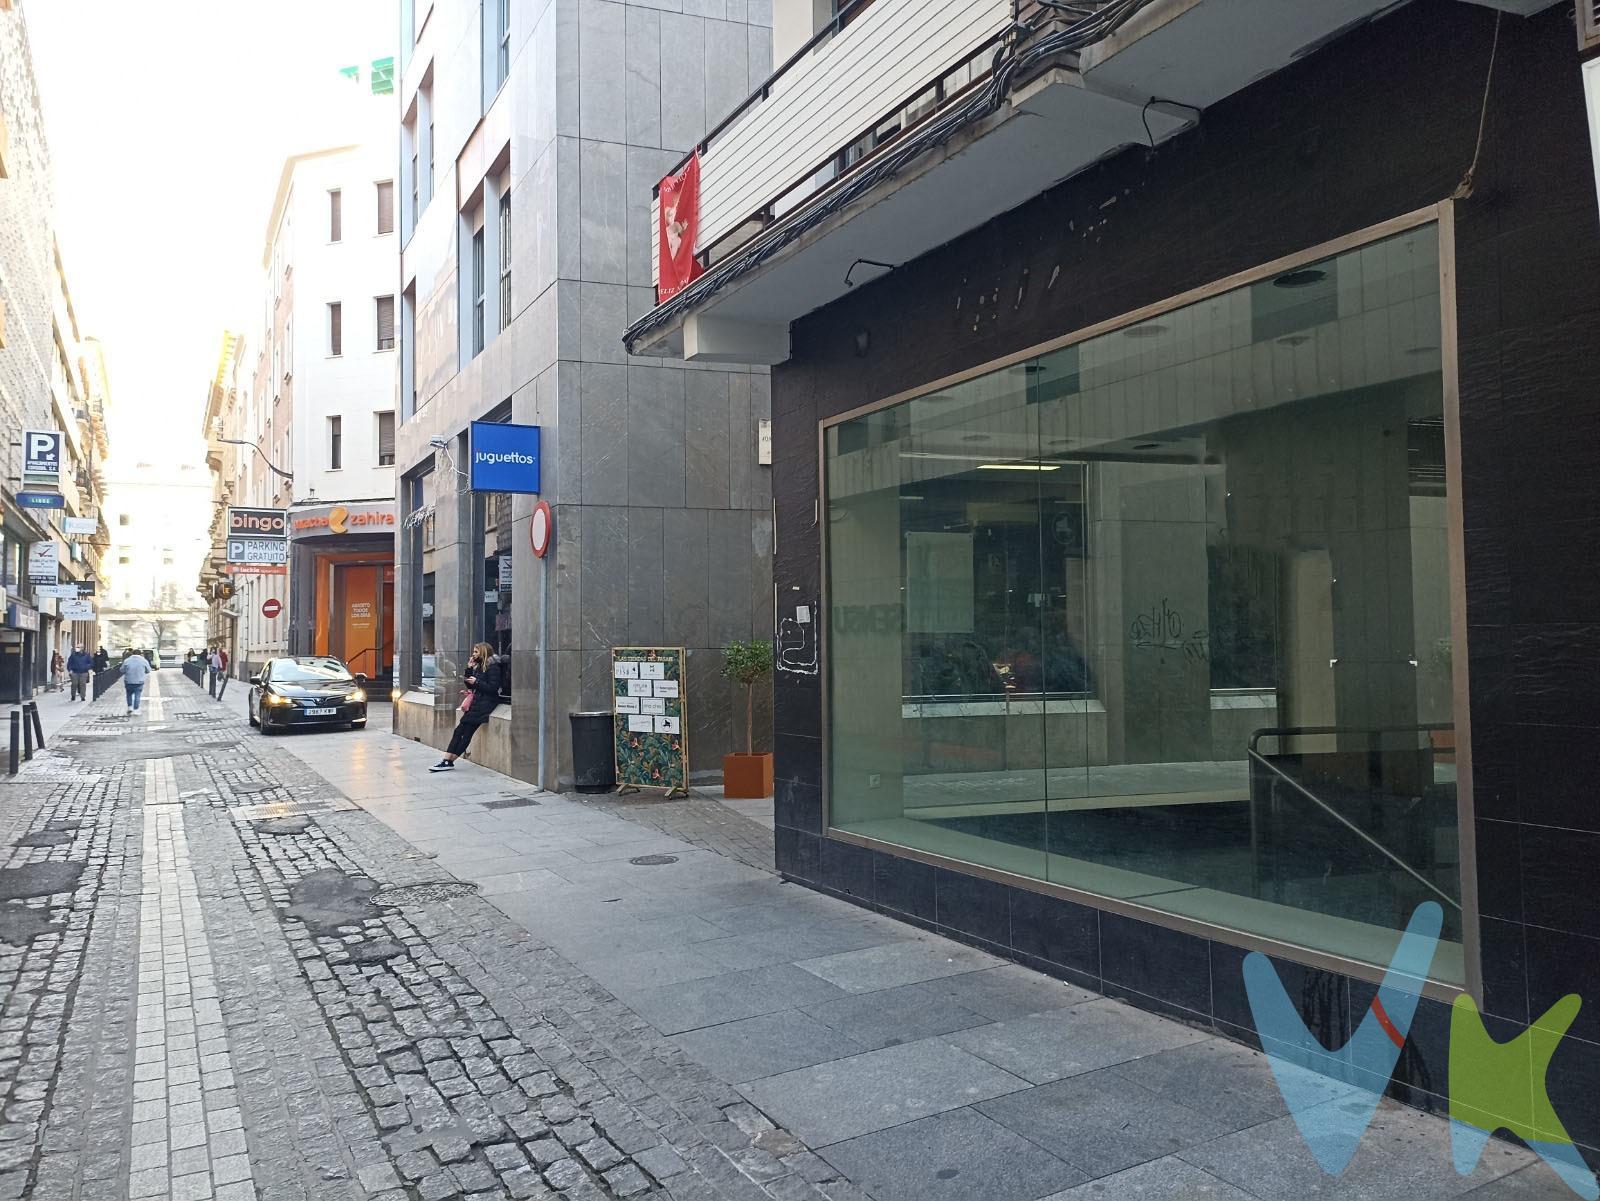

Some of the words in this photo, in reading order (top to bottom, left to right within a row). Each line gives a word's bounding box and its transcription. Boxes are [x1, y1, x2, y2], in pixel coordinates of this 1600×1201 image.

[30, 433, 55, 460] P
[475, 449, 533, 464] juguettos
[231, 512, 284, 532] bingo
[350, 511, 395, 526] zahira
[231, 542, 244, 558] P
[247, 541, 285, 552] PARKING
[247, 552, 285, 561] GRATUITO
